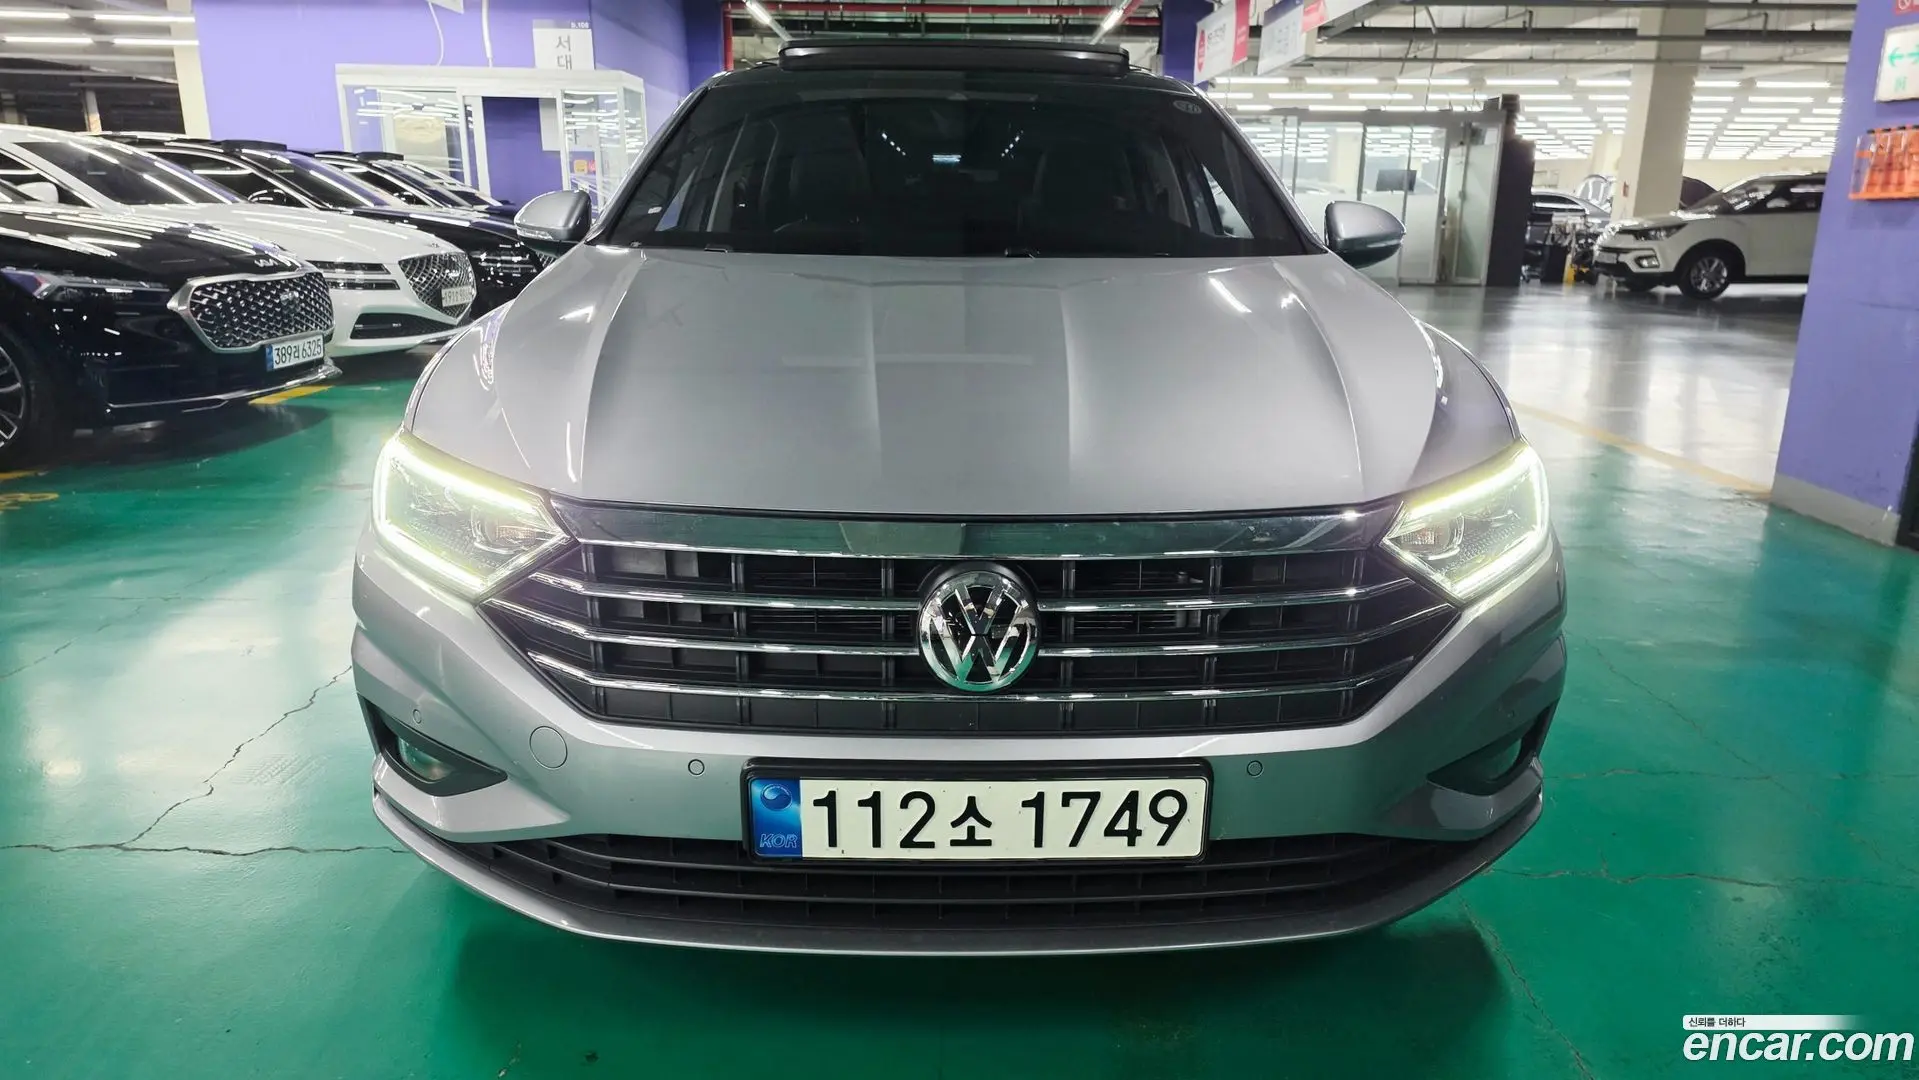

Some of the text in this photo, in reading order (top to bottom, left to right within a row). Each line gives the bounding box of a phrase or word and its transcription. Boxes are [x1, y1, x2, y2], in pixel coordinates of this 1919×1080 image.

[302, 339, 322, 359] 6325
[812, 789, 1188, 849] 112소 1749
[759, 833, 798, 848] KOR
